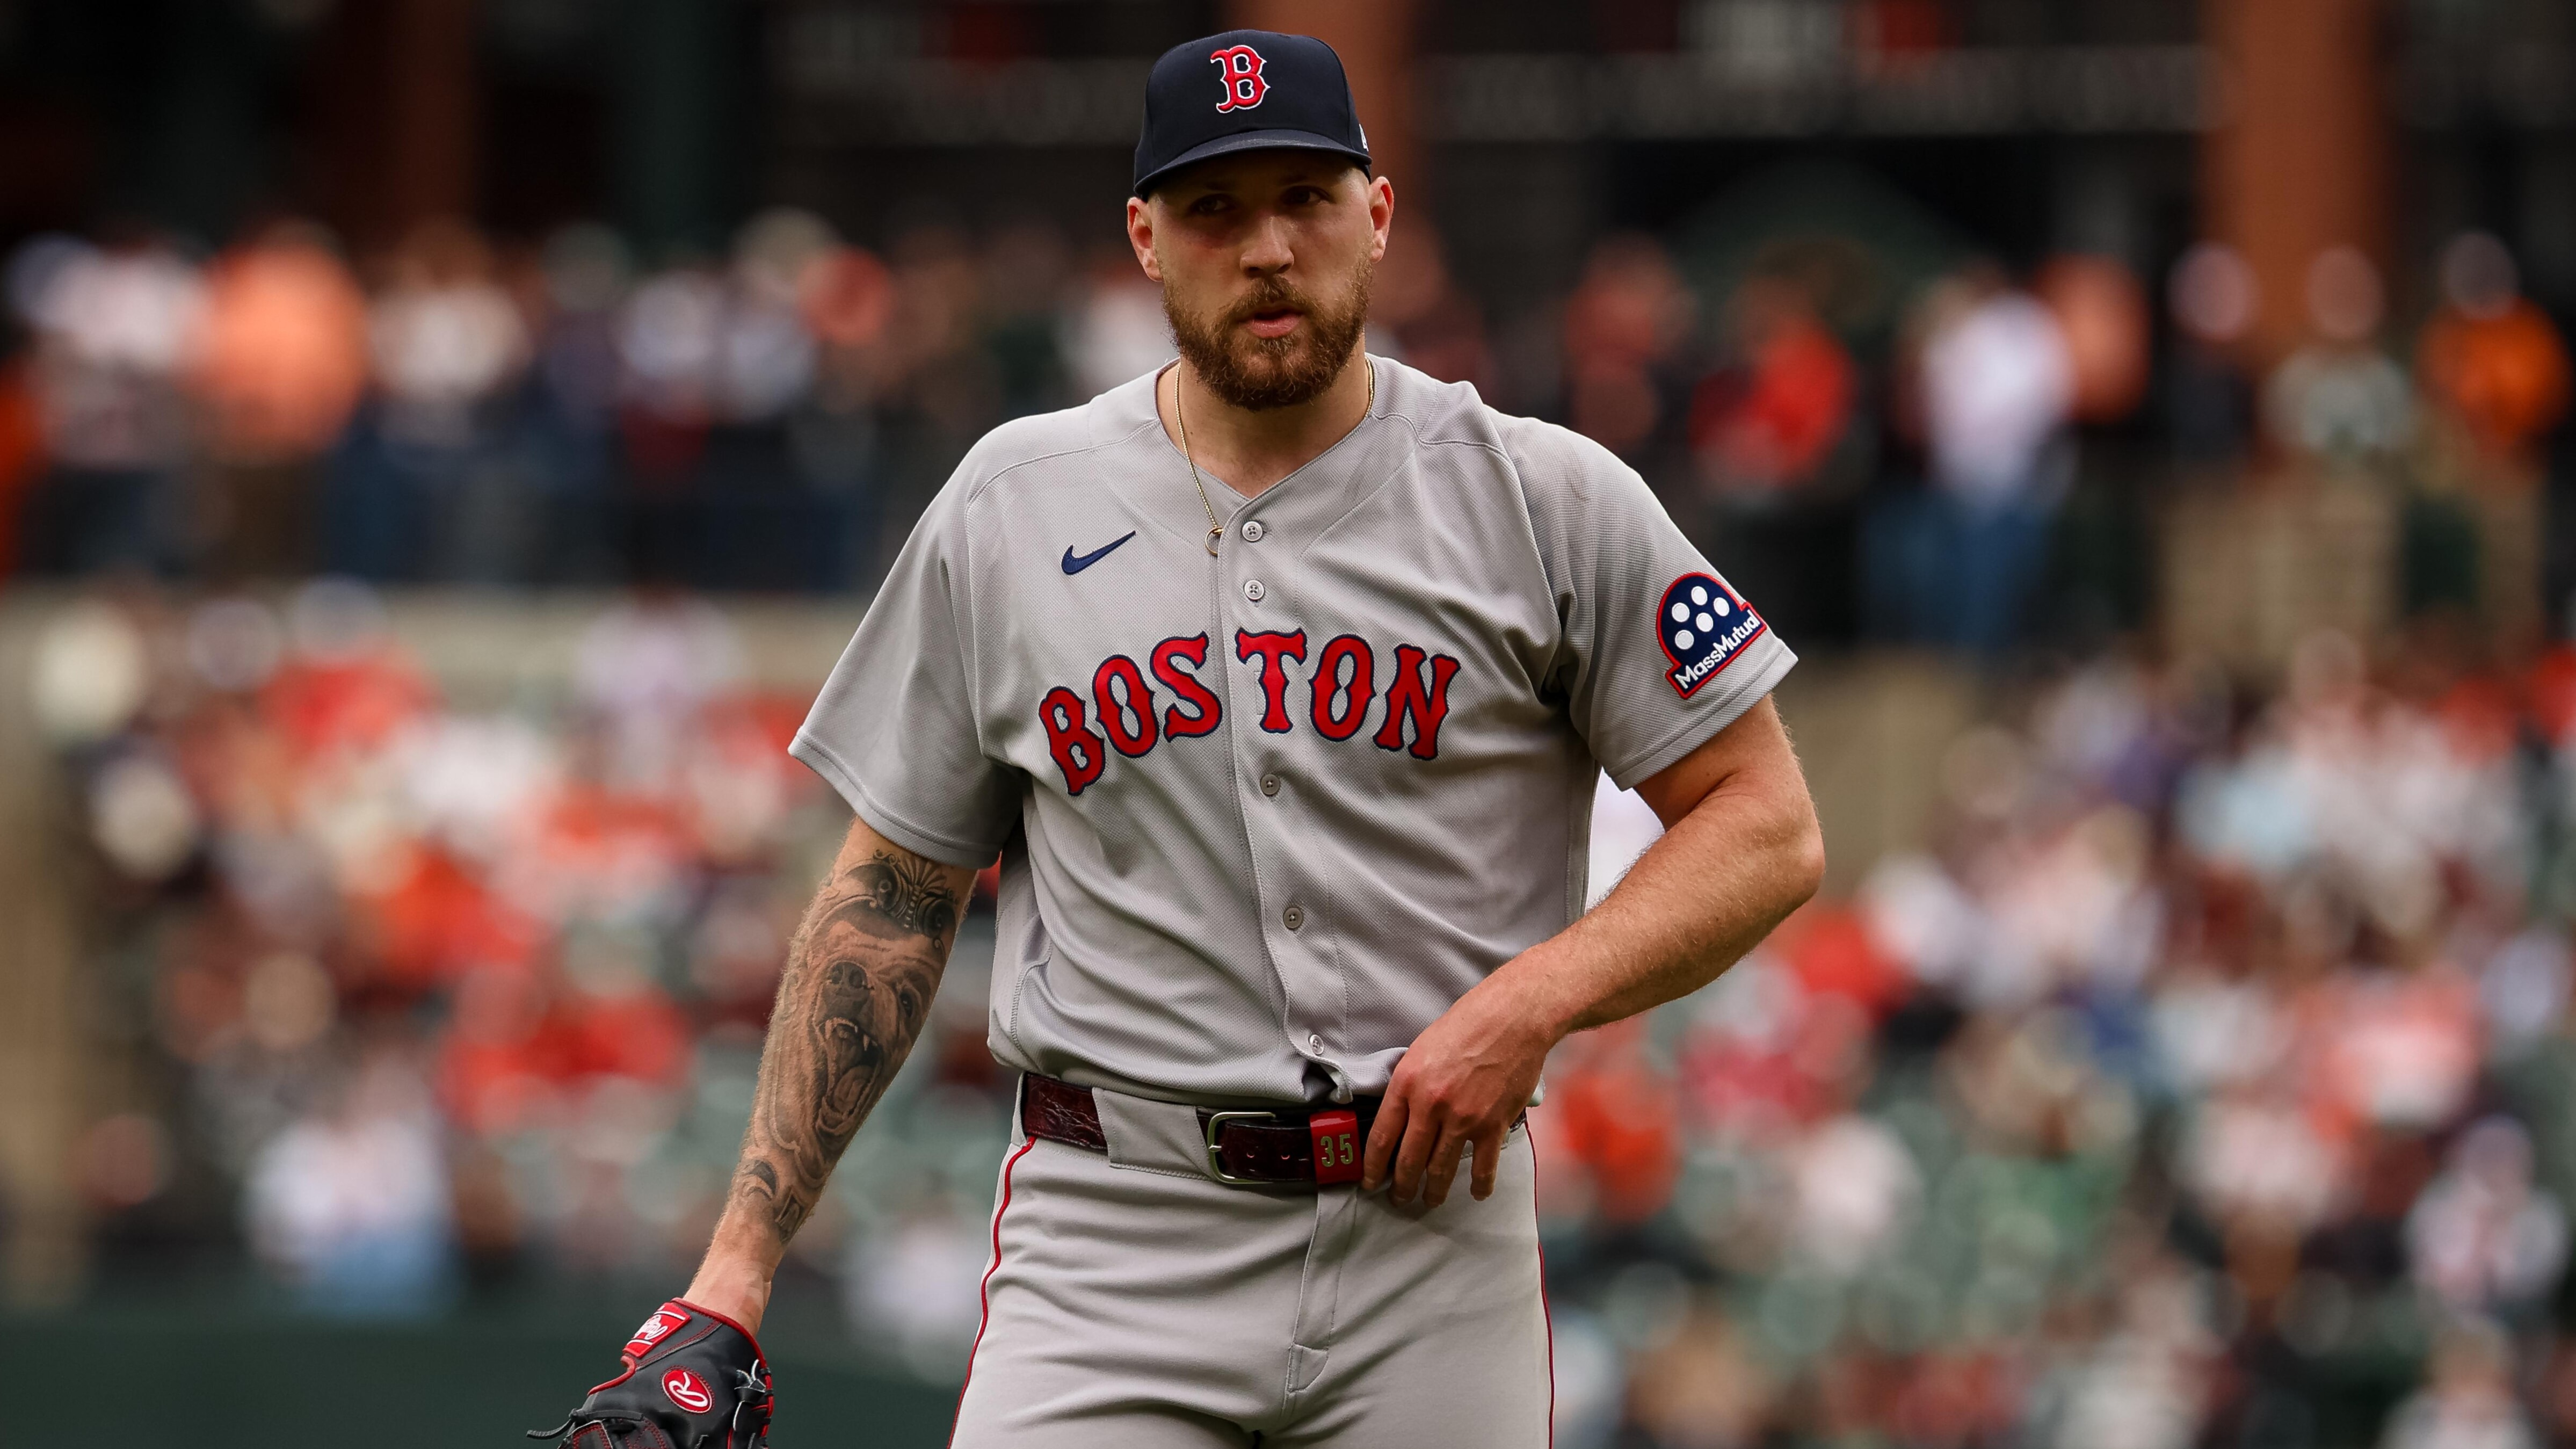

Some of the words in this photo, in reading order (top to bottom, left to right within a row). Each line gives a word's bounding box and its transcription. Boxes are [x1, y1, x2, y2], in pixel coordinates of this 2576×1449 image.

[1210, 45, 1271, 113] B
[1675, 609, 1761, 690] MassMutual
[1039, 626, 1462, 796] BOSTON
[1320, 1134, 1353, 1167] 35
